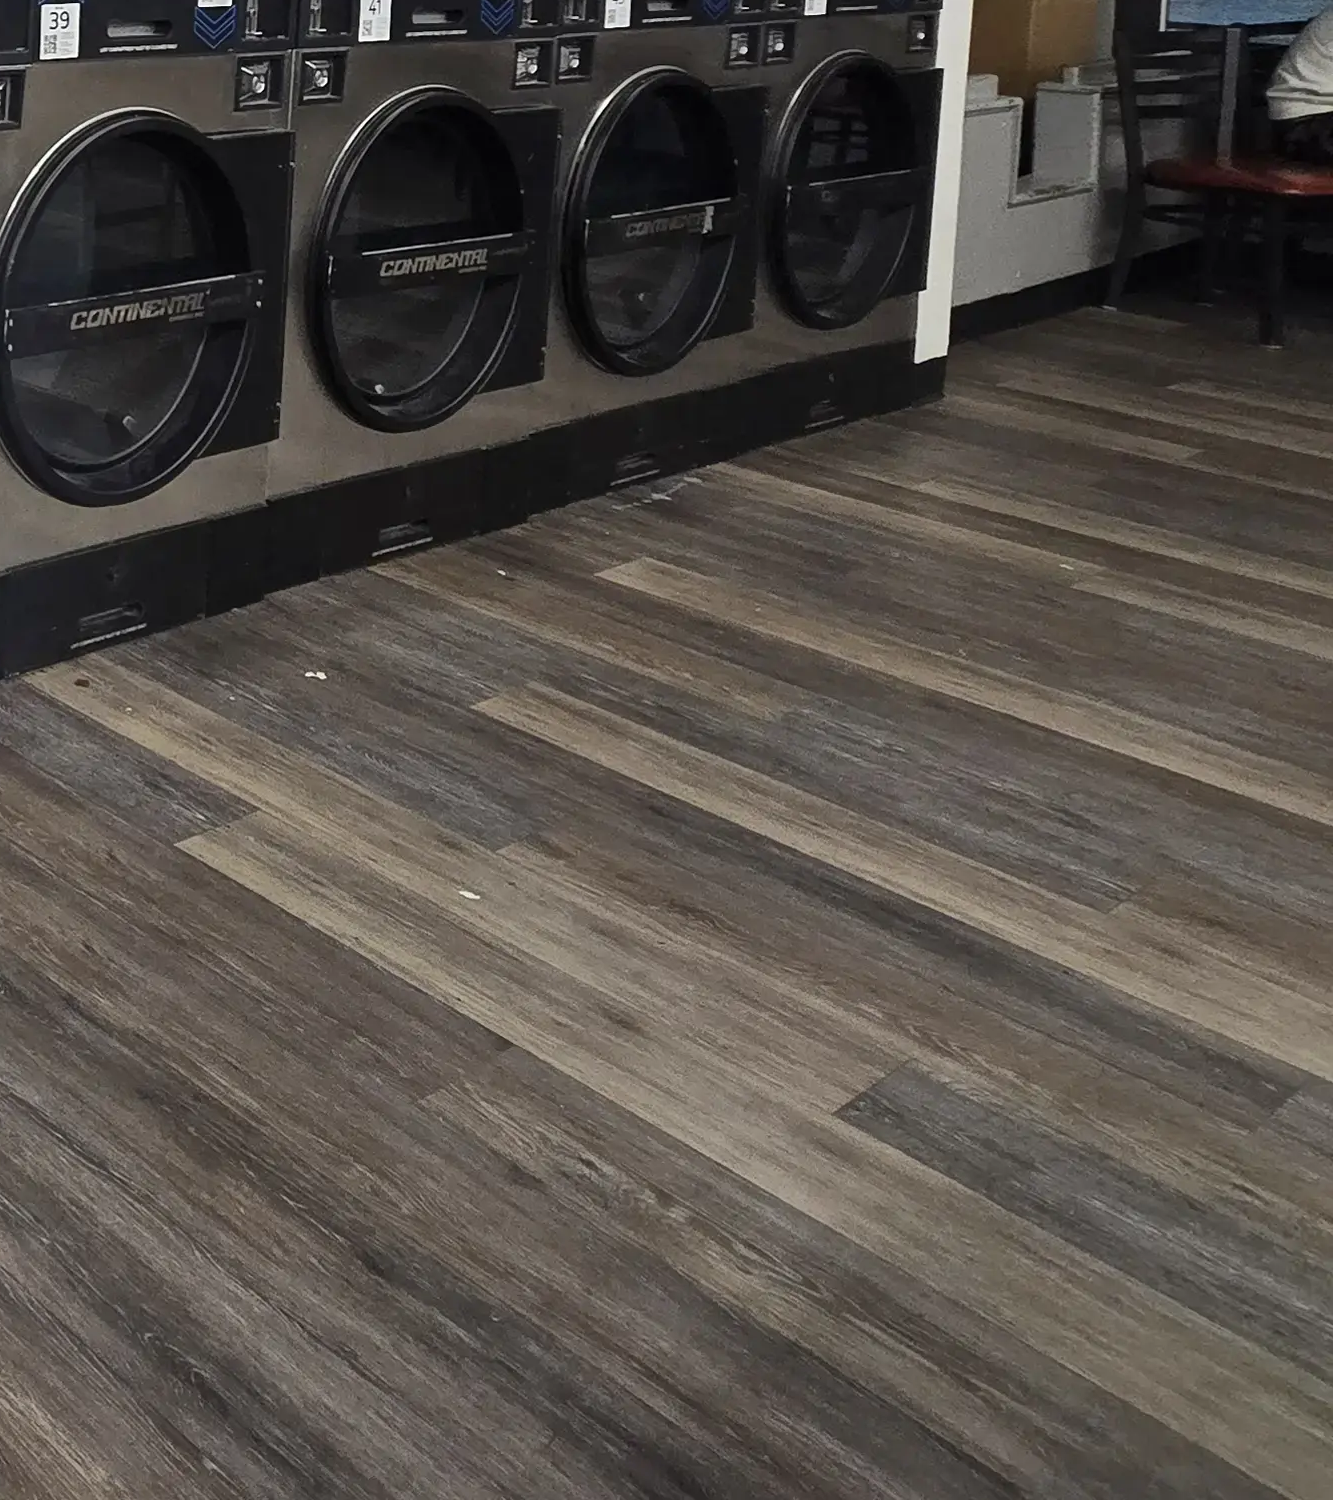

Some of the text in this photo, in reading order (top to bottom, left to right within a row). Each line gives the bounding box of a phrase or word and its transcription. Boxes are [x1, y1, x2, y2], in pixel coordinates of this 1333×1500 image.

[368, 0, 381, 15] 41
[49, 11, 70, 30] 39
[379, 247, 489, 278] CONTINENTAL
[70, 291, 206, 331] CONTINENTAL
